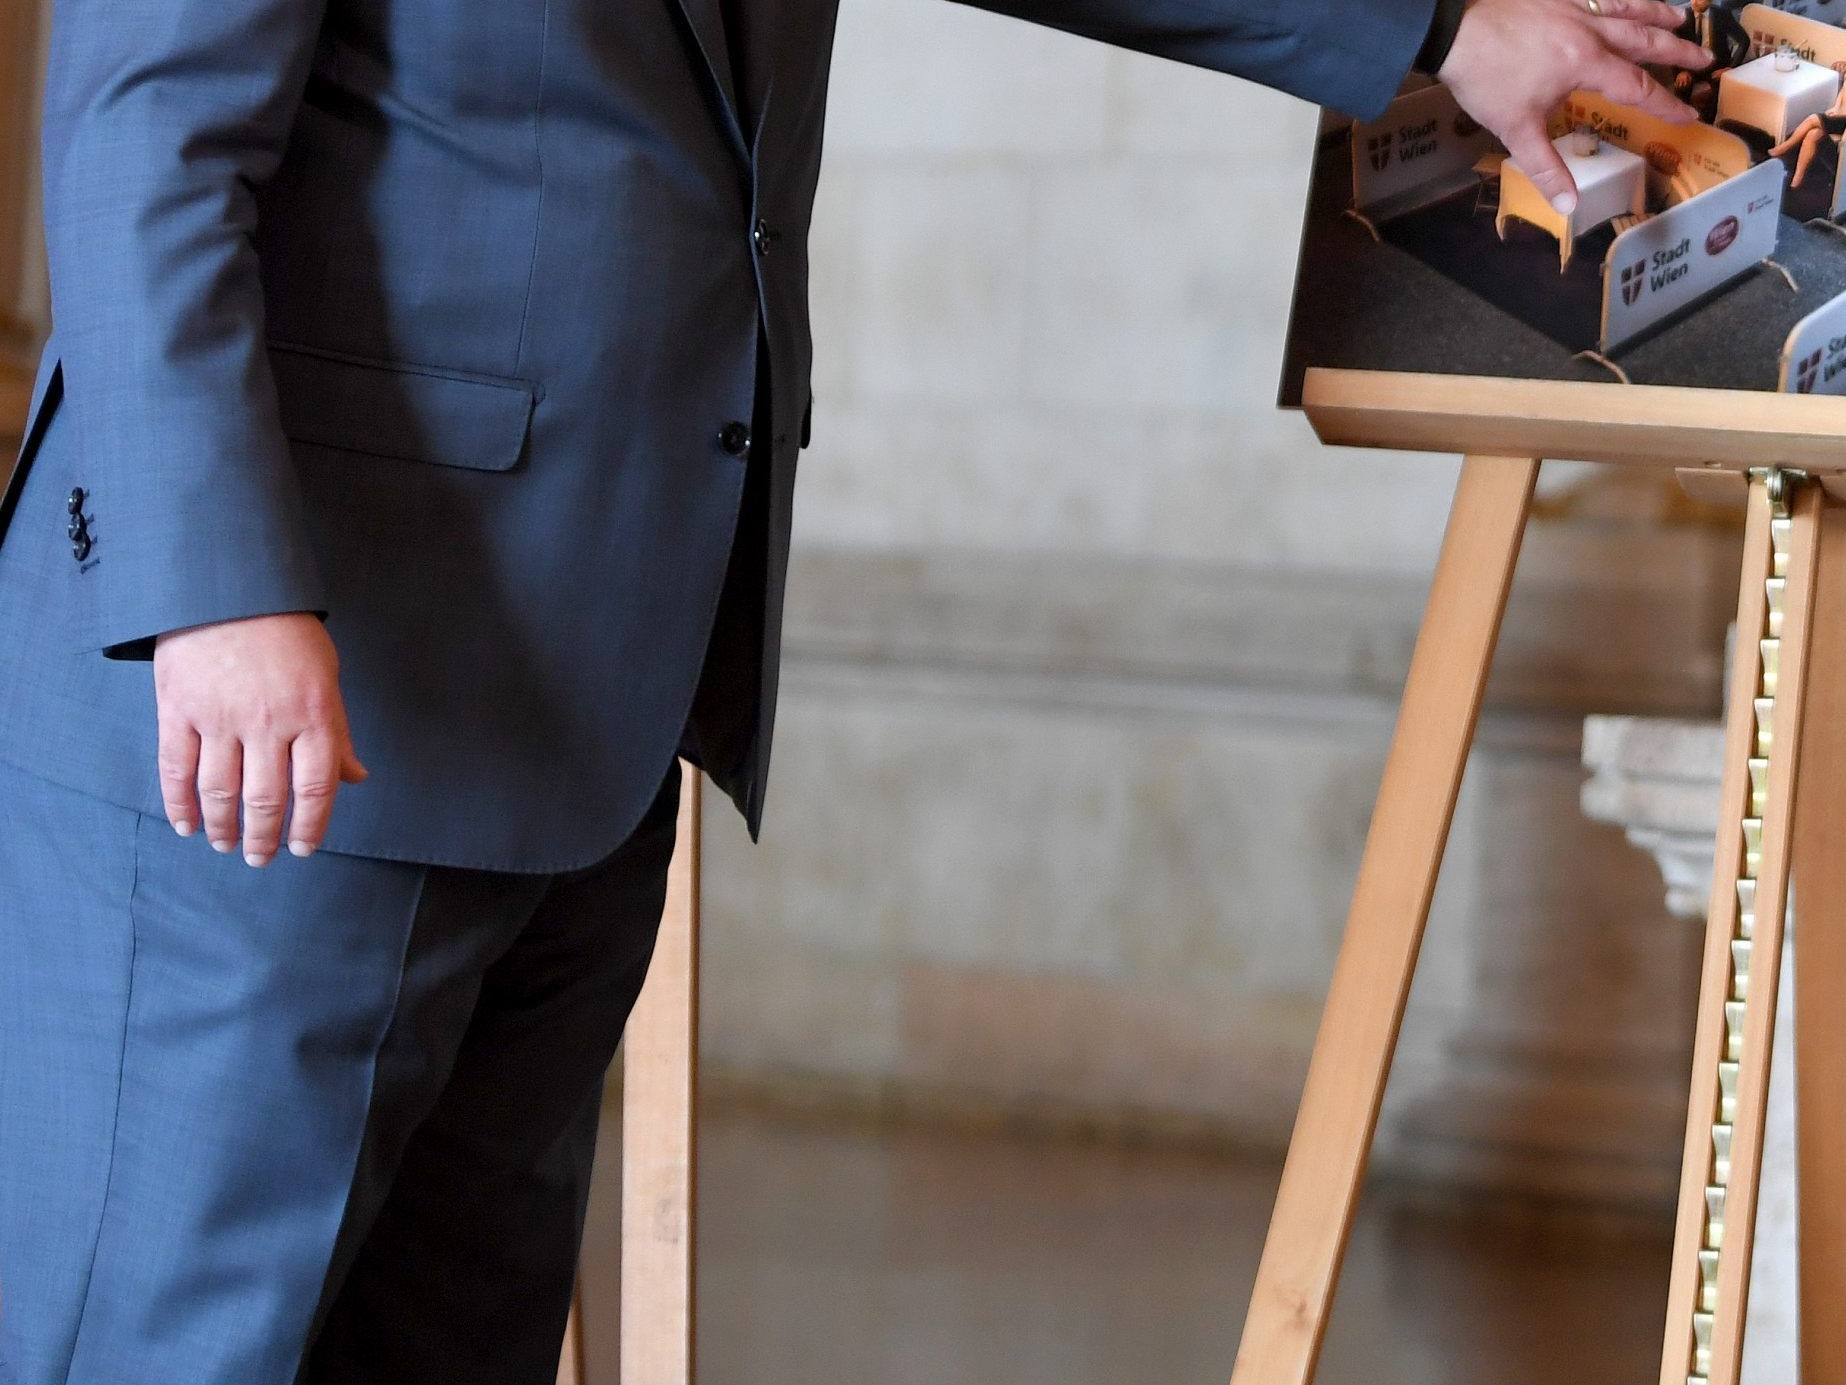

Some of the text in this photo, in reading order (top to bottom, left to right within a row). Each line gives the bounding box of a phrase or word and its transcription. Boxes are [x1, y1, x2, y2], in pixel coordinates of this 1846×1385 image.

[1399, 118, 1438, 144] Stadt
[1399, 140, 1438, 163] Wien
[1652, 237, 1692, 271] Stadt
[1650, 262, 1689, 293] Wien
